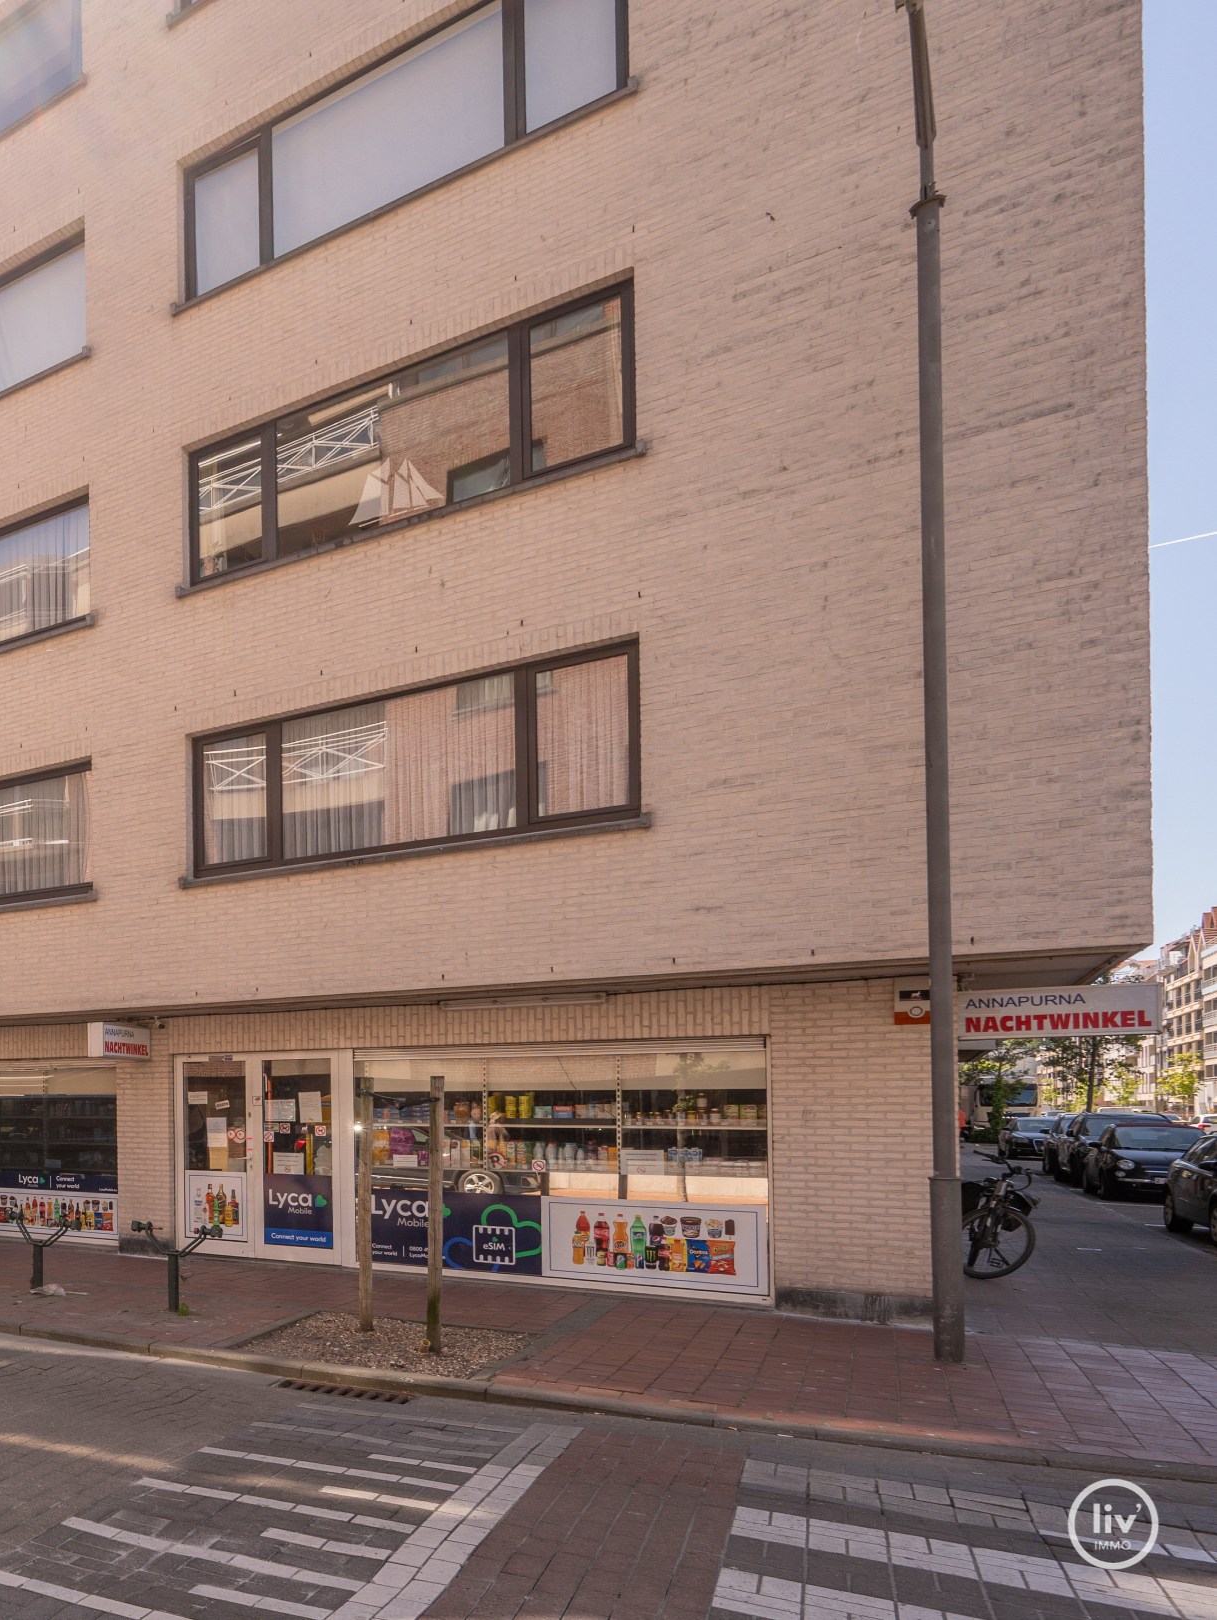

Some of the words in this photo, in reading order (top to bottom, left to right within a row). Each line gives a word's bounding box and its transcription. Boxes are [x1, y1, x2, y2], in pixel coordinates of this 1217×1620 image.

[965, 993, 1086, 1009] ANNAPURNA
[965, 1010, 1152, 1033] NACHTWINKEL
[104, 1027, 135, 1038] ANNAPURNA
[104, 1040, 149, 1056] NACHTWINKEL
[18, 1174, 39, 1185] Lyca
[268, 1189, 312, 1208] Lyca
[287, 1207, 312, 1215] Mobile
[371, 1195, 429, 1219] Lyca
[396, 1217, 429, 1228] Mobile
[270, 1232, 295, 1241] Connect
[482, 1242, 505, 1251] eSIM
